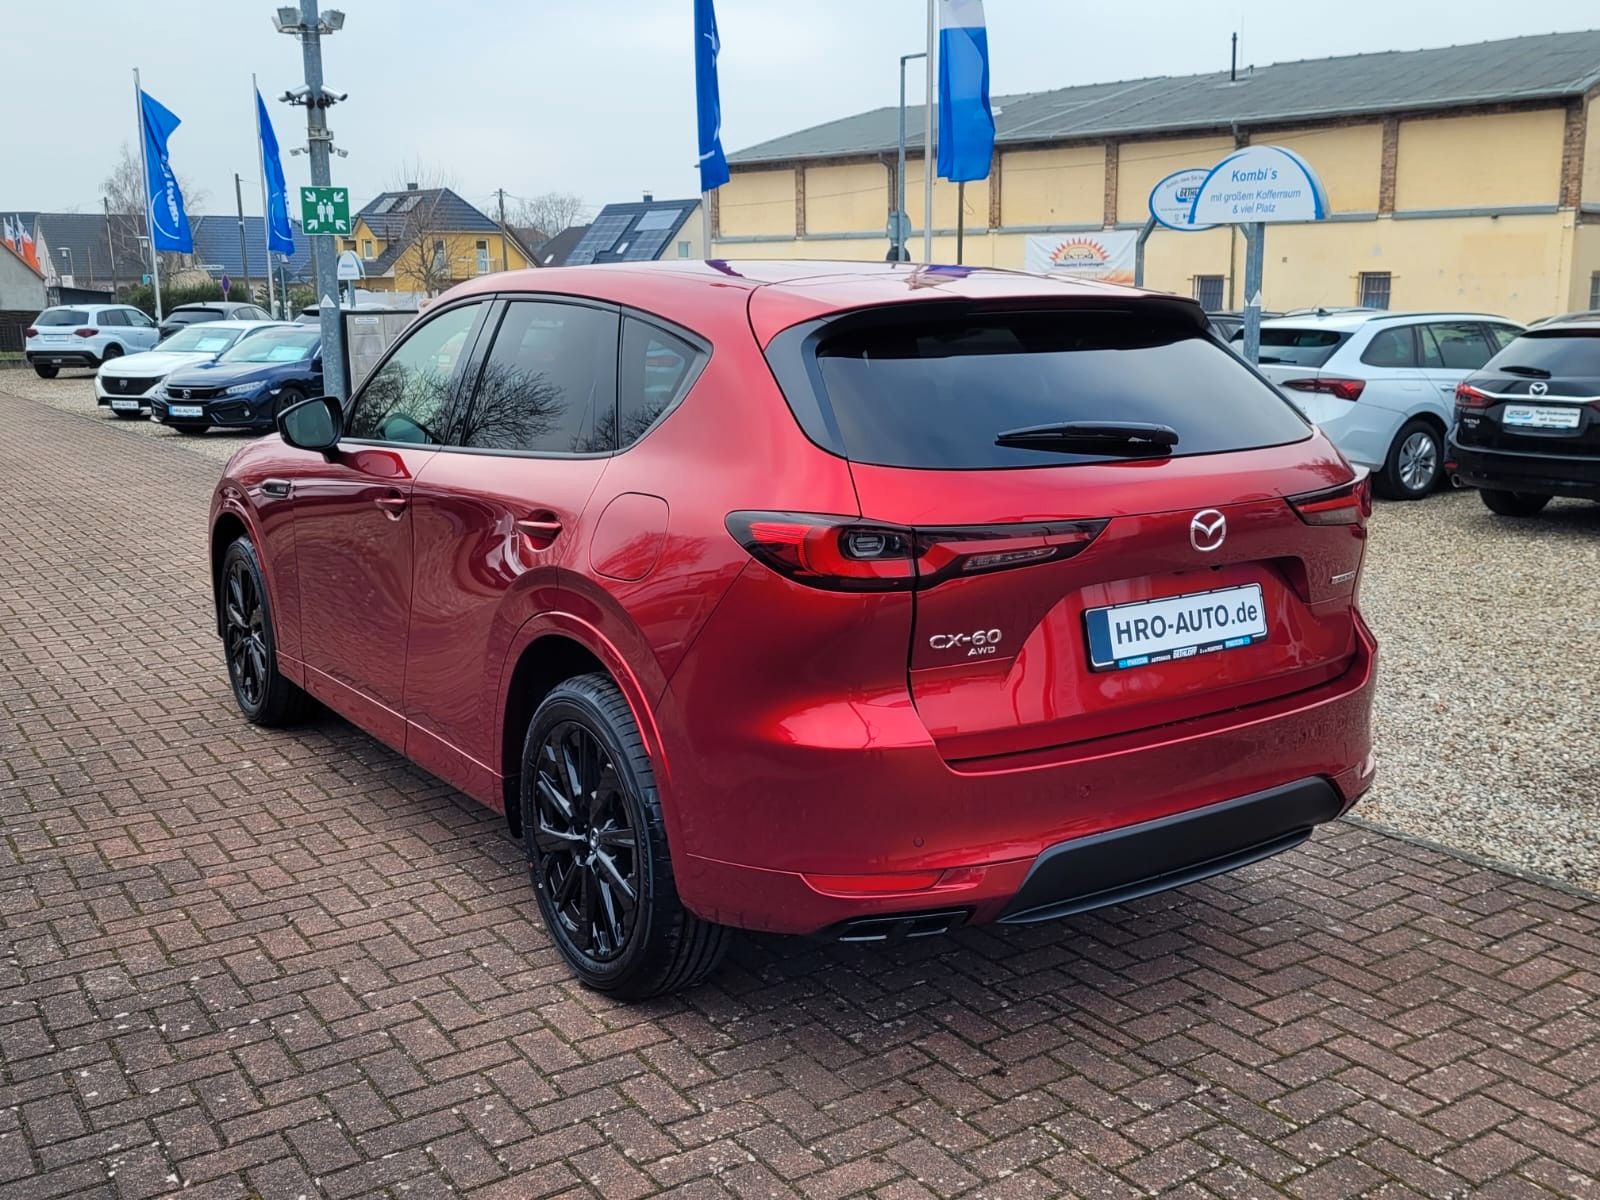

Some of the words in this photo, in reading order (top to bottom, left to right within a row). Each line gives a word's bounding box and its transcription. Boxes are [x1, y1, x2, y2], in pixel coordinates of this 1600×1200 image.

[1210, 191, 1223, 203] mit
[1224, 190, 1255, 204] großem
[1255, 188, 1302, 201] Kofferraum
[1232, 204, 1239, 215] &
[1240, 203, 1255, 214] viel
[1255, 202, 1277, 214] Platz
[1115, 601, 1258, 645] HRO-AUTO.de
[929, 628, 1002, 649] CX-60
[967, 646, 996, 657] AWD
